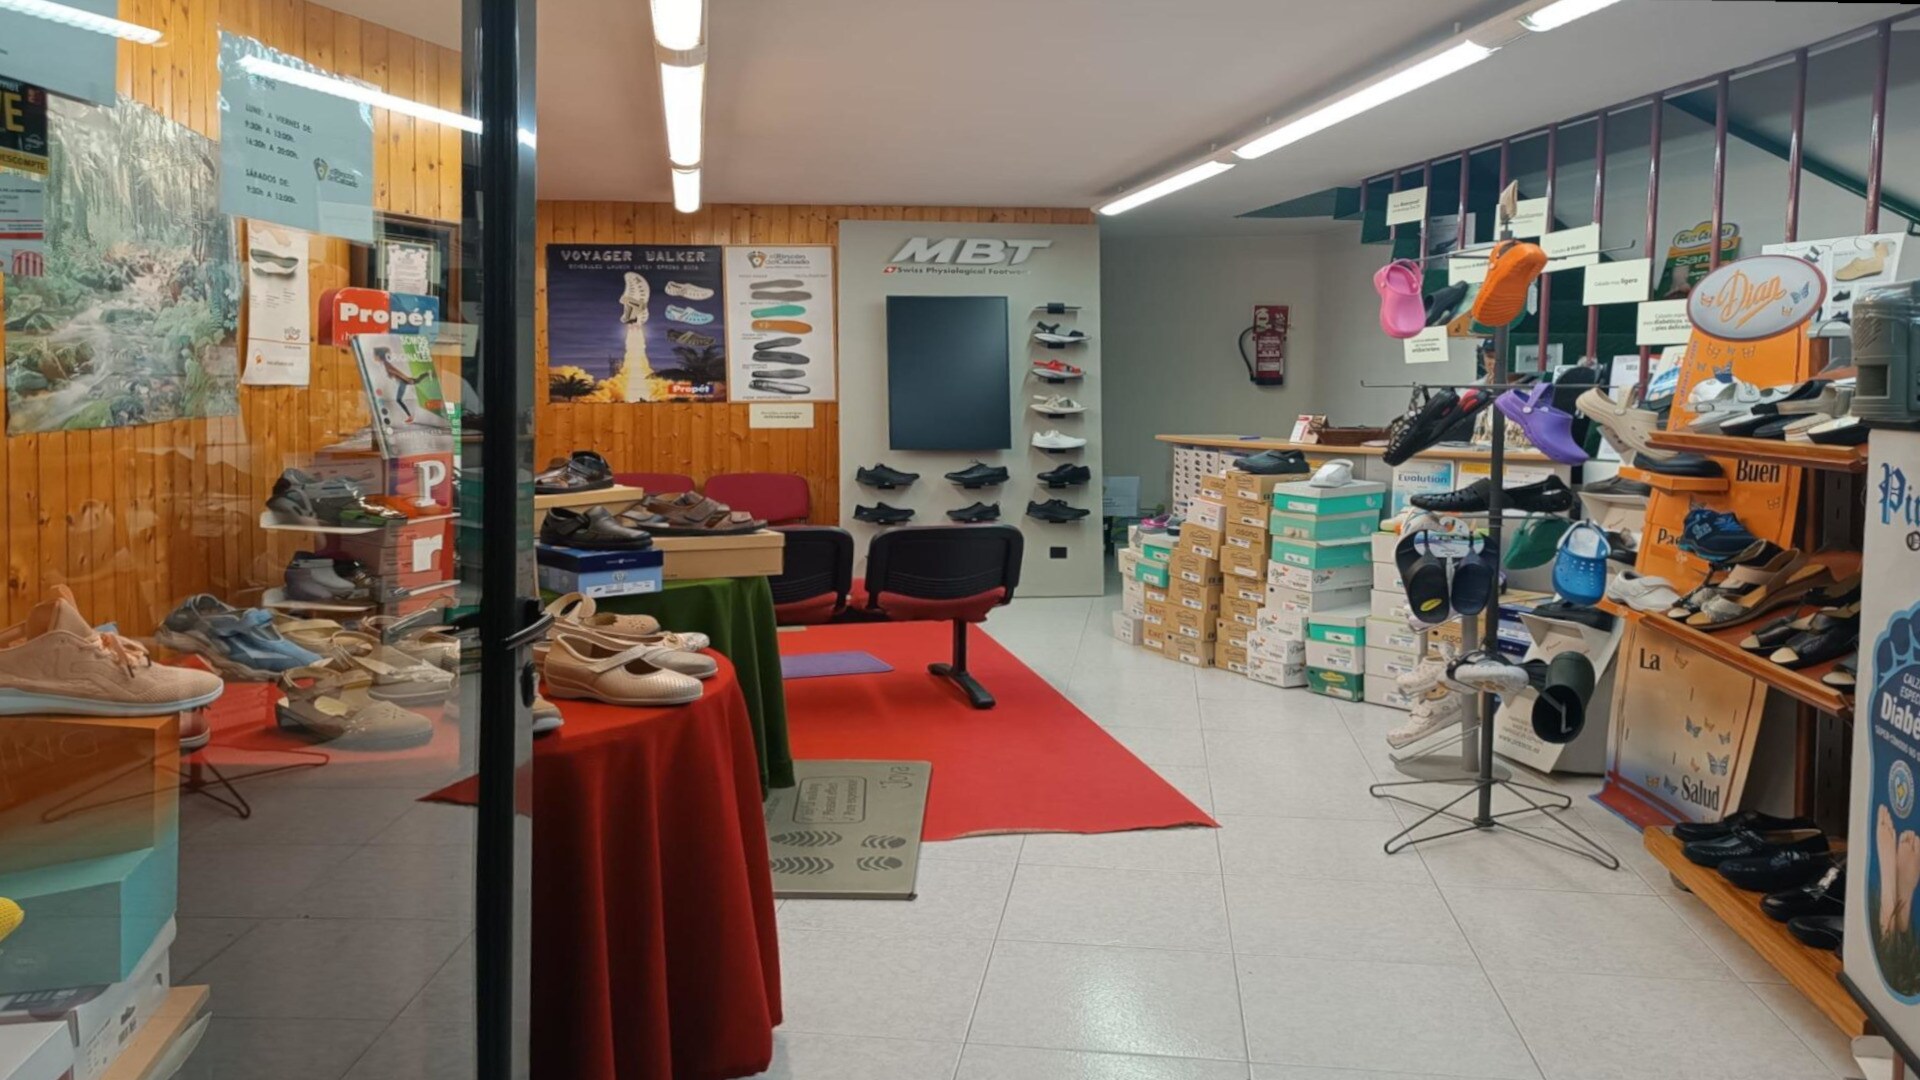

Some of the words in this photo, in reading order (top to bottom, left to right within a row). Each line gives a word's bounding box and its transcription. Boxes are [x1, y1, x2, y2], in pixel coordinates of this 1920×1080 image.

[561, 250, 632, 262] VOYAGER
[646, 251, 706, 262] WALKER
[892, 237, 1053, 265] MBT
[897, 266, 923, 274] Swiss
[926, 266, 986, 276] Physiological
[1620, 277, 1638, 285] ligero
[340, 302, 434, 329] Propét
[673, 384, 710, 394] Propét
[1398, 473, 1448, 484] Evolution
[1736, 459, 1781, 483] Buen
[1640, 648, 1661, 671] La
[1681, 774, 1720, 811] Salud
